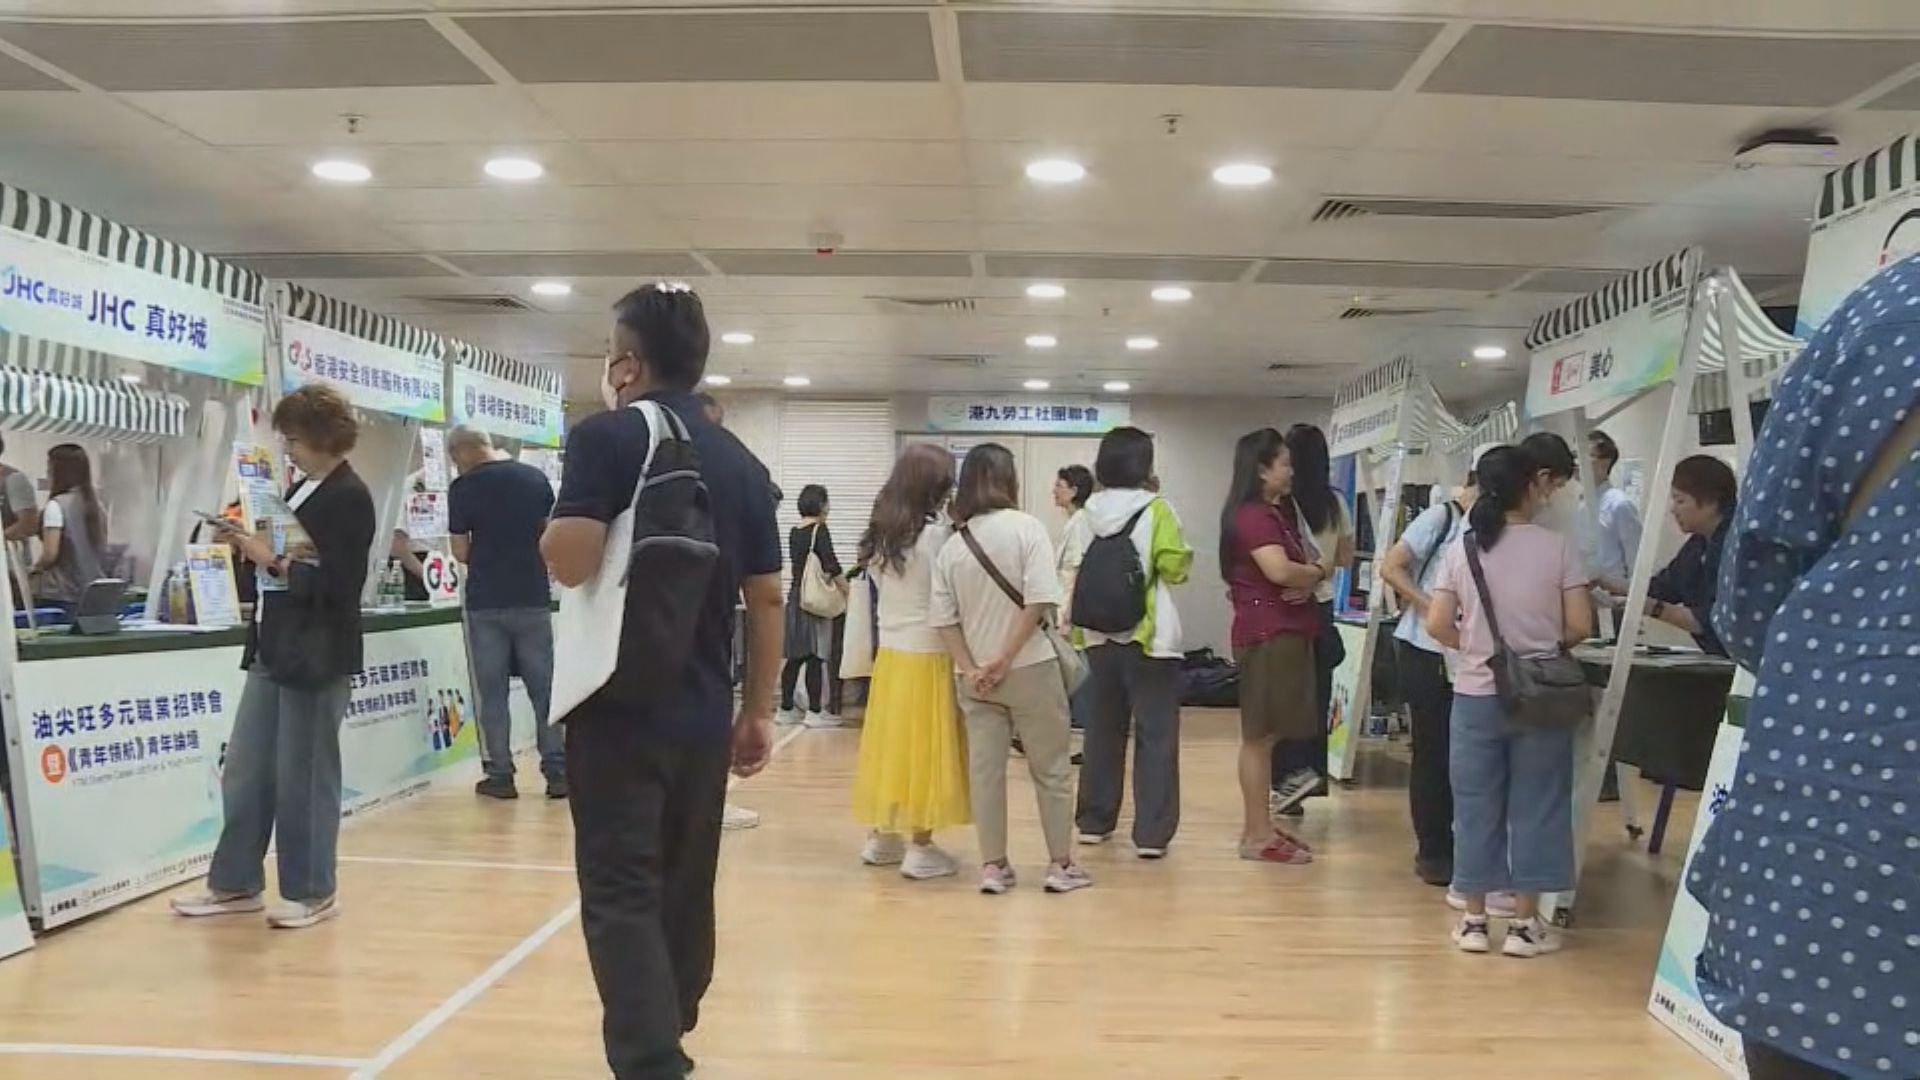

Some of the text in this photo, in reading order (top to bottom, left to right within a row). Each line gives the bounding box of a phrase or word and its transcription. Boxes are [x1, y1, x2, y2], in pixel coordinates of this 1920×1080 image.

[3, 273, 44, 304] JHC
[88, 290, 137, 331] JHC
[145, 303, 208, 350] 真好城
[968, 405, 1099, 422] 港九勞工社團聯會
[32, 689, 222, 740] 油尖旺多元職業招聘會
